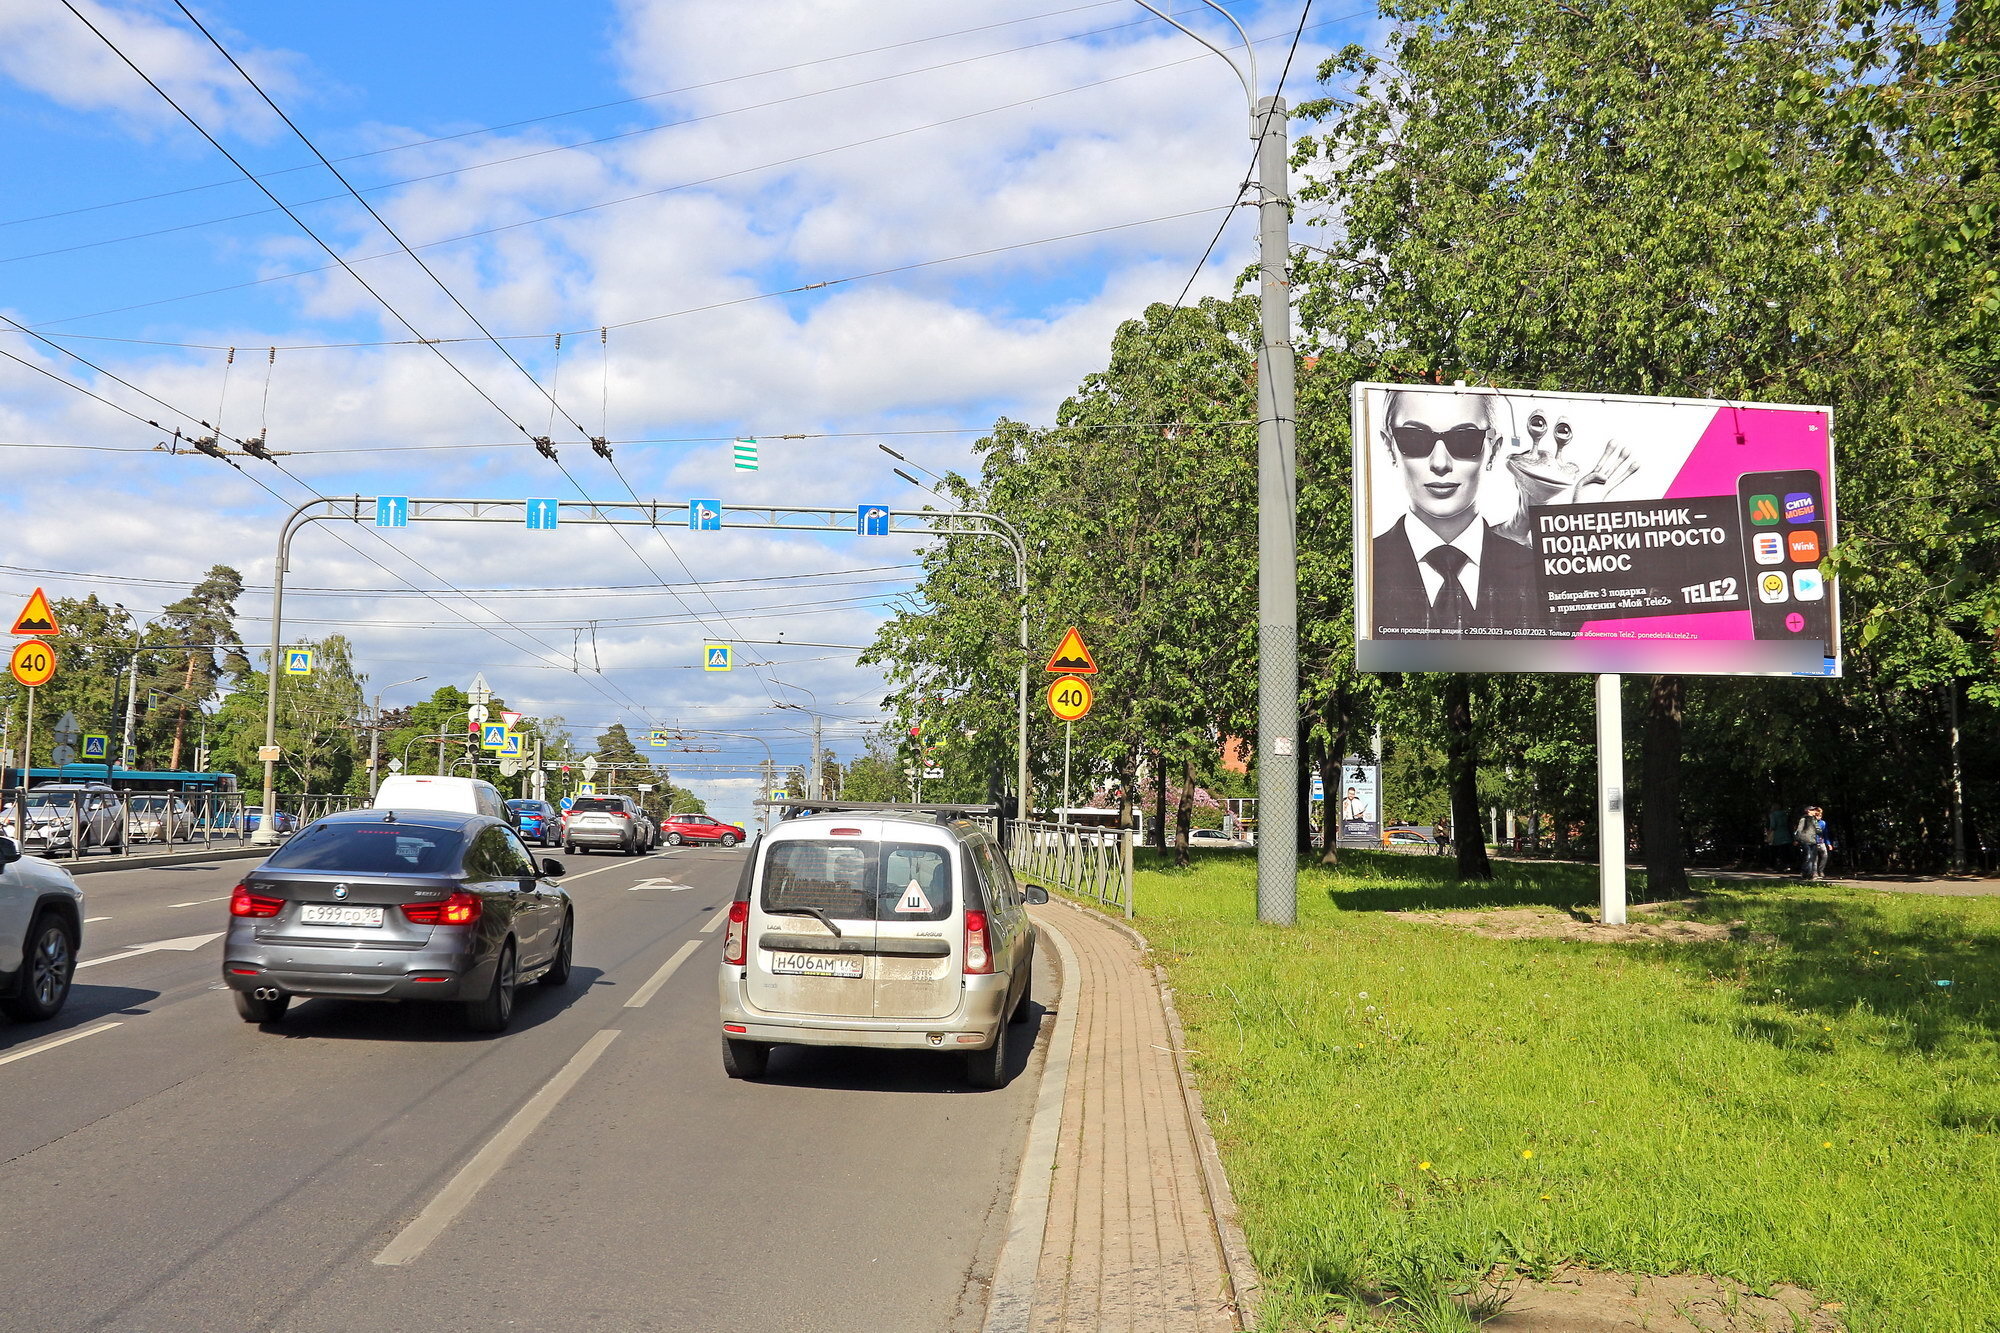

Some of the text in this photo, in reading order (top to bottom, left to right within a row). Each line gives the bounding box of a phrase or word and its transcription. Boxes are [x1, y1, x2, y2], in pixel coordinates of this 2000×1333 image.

[1785, 497, 1813, 510] СИТИ
[1540, 508, 1691, 533] ПОНЕДЕЛЬНИК
[1542, 527, 1726, 556] ПОДАРКИ ПРОСТО
[1791, 542, 1816, 551] Wink
[1544, 553, 1632, 576] КОСМОС
[1548, 587, 1647, 601] Выбирайте 3 подарка
[1681, 577, 1739, 604] TELE2
[1549, 597, 1672, 614] в приложении «Мой Tele2»
[1378, 626, 1400, 635] Сроки
[1400, 627, 1440, 636] проведения
[1441, 628, 1463, 636] акции:
[1469, 627, 1503, 636] 29.05.2023
[1503, 629, 1513, 637] по
[1513, 628, 1548, 637] 03.07.2023.
[1549, 629, 1571, 637] Только
[1571, 630, 1584, 638] для
[1584, 630, 1618, 638] абонентов
[1619, 630, 1637, 639] Tele2.
[1637, 631, 1698, 640] ponedelniki.tele2.ru
[20, 653, 46, 672] 40
[1057, 689, 1083, 707] 40
[907, 896, 920, 908] Ш
